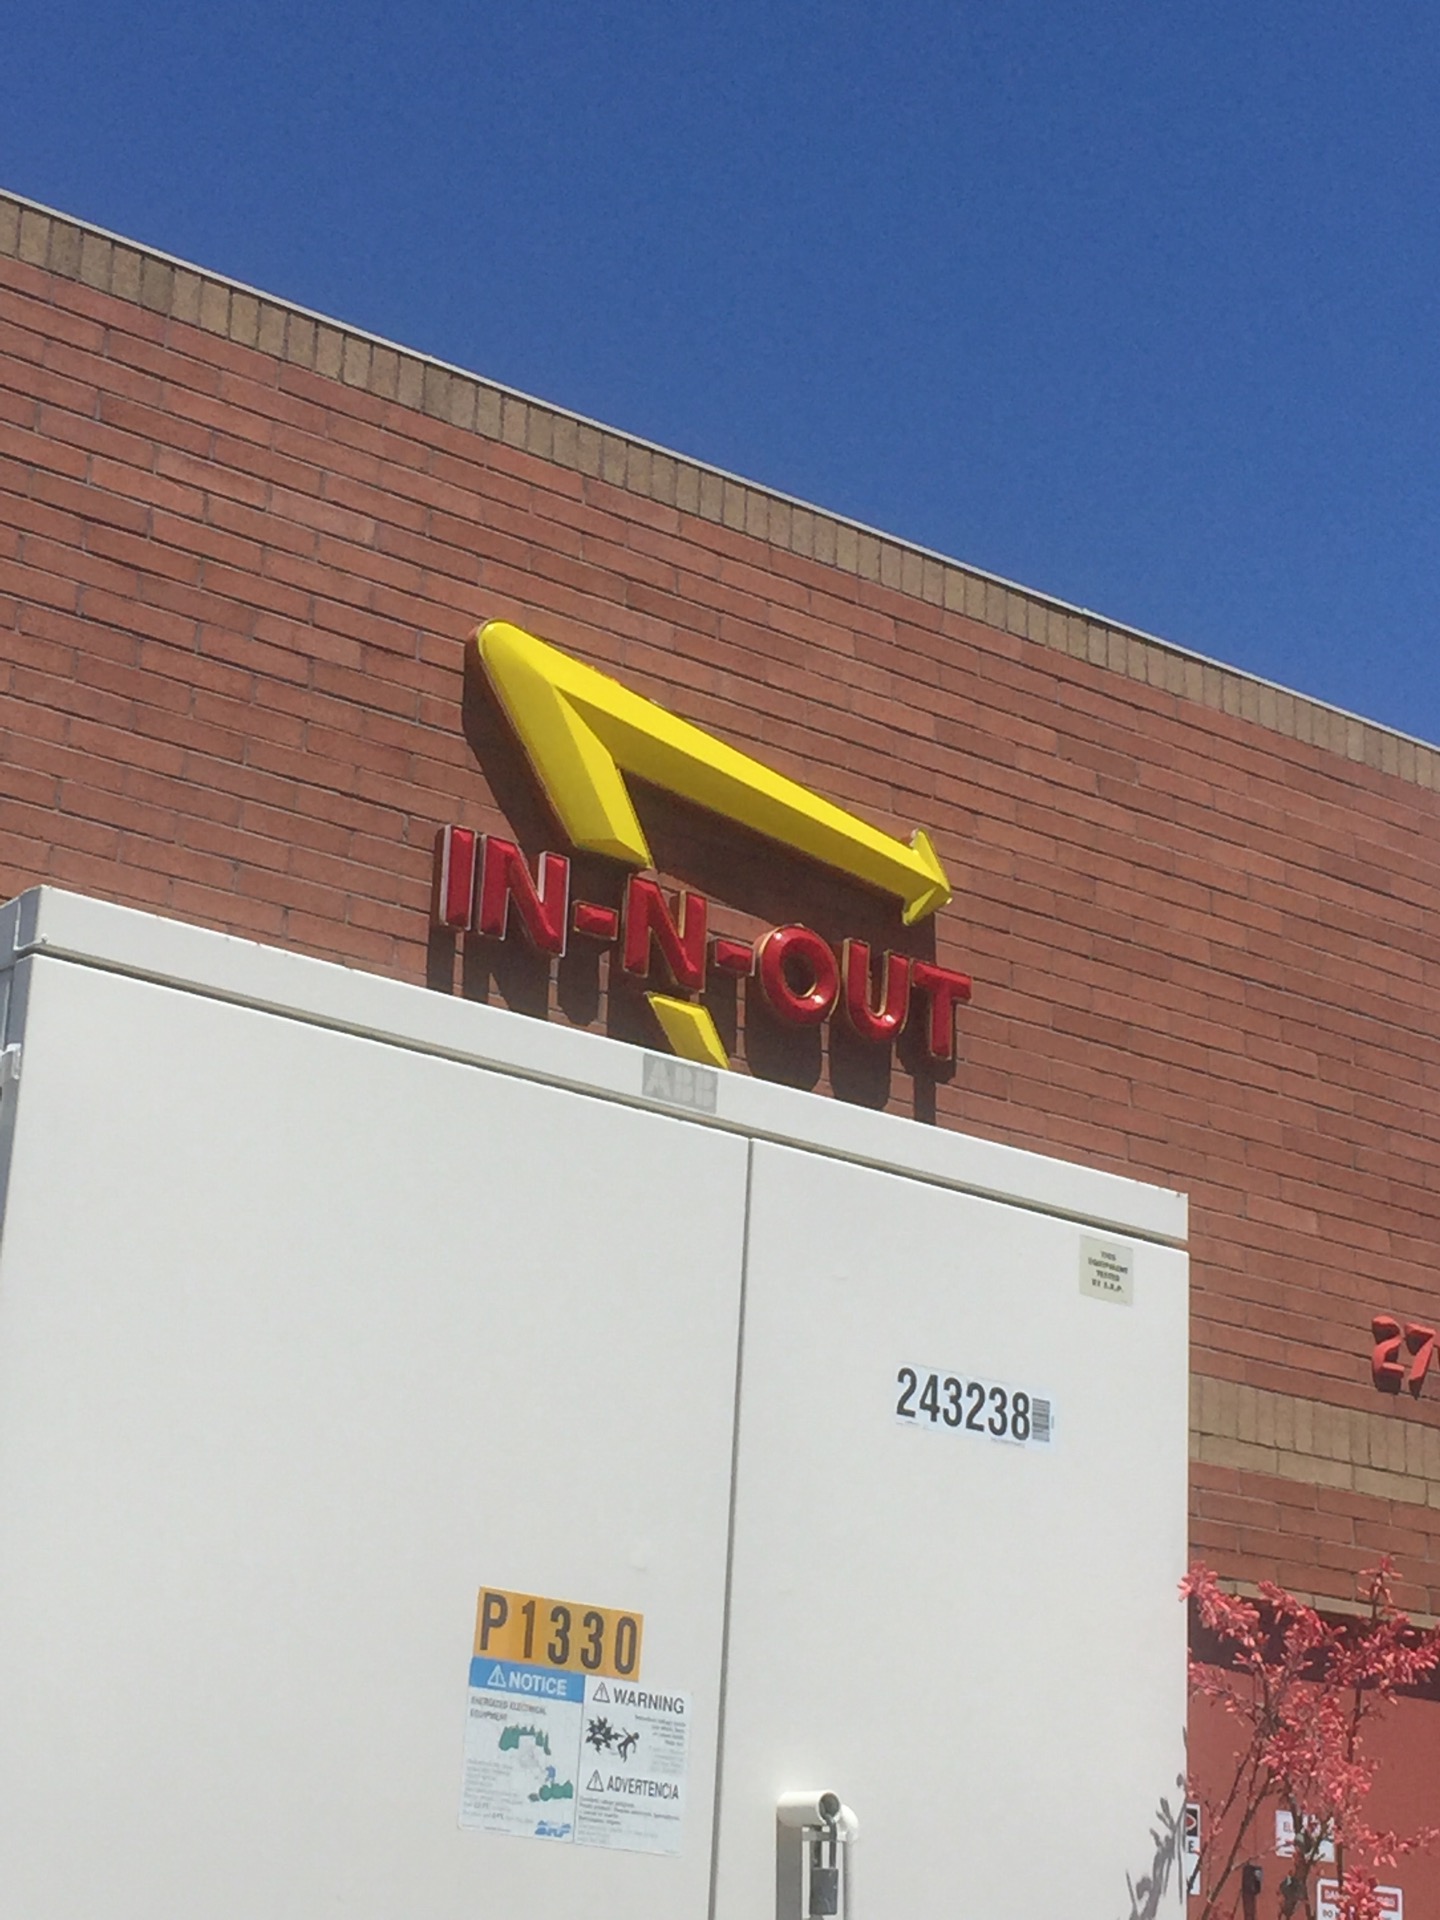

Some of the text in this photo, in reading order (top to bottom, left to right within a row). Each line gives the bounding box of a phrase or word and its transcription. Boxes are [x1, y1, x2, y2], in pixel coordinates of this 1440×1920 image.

[434, 824, 973, 1061] IN-N-OUT
[896, 1367, 1030, 1441] 243238
[508, 1672, 567, 1696] NOTICE
[613, 1687, 685, 1714] WARNING
[607, 1775, 679, 1799] ADVERTENCIA
